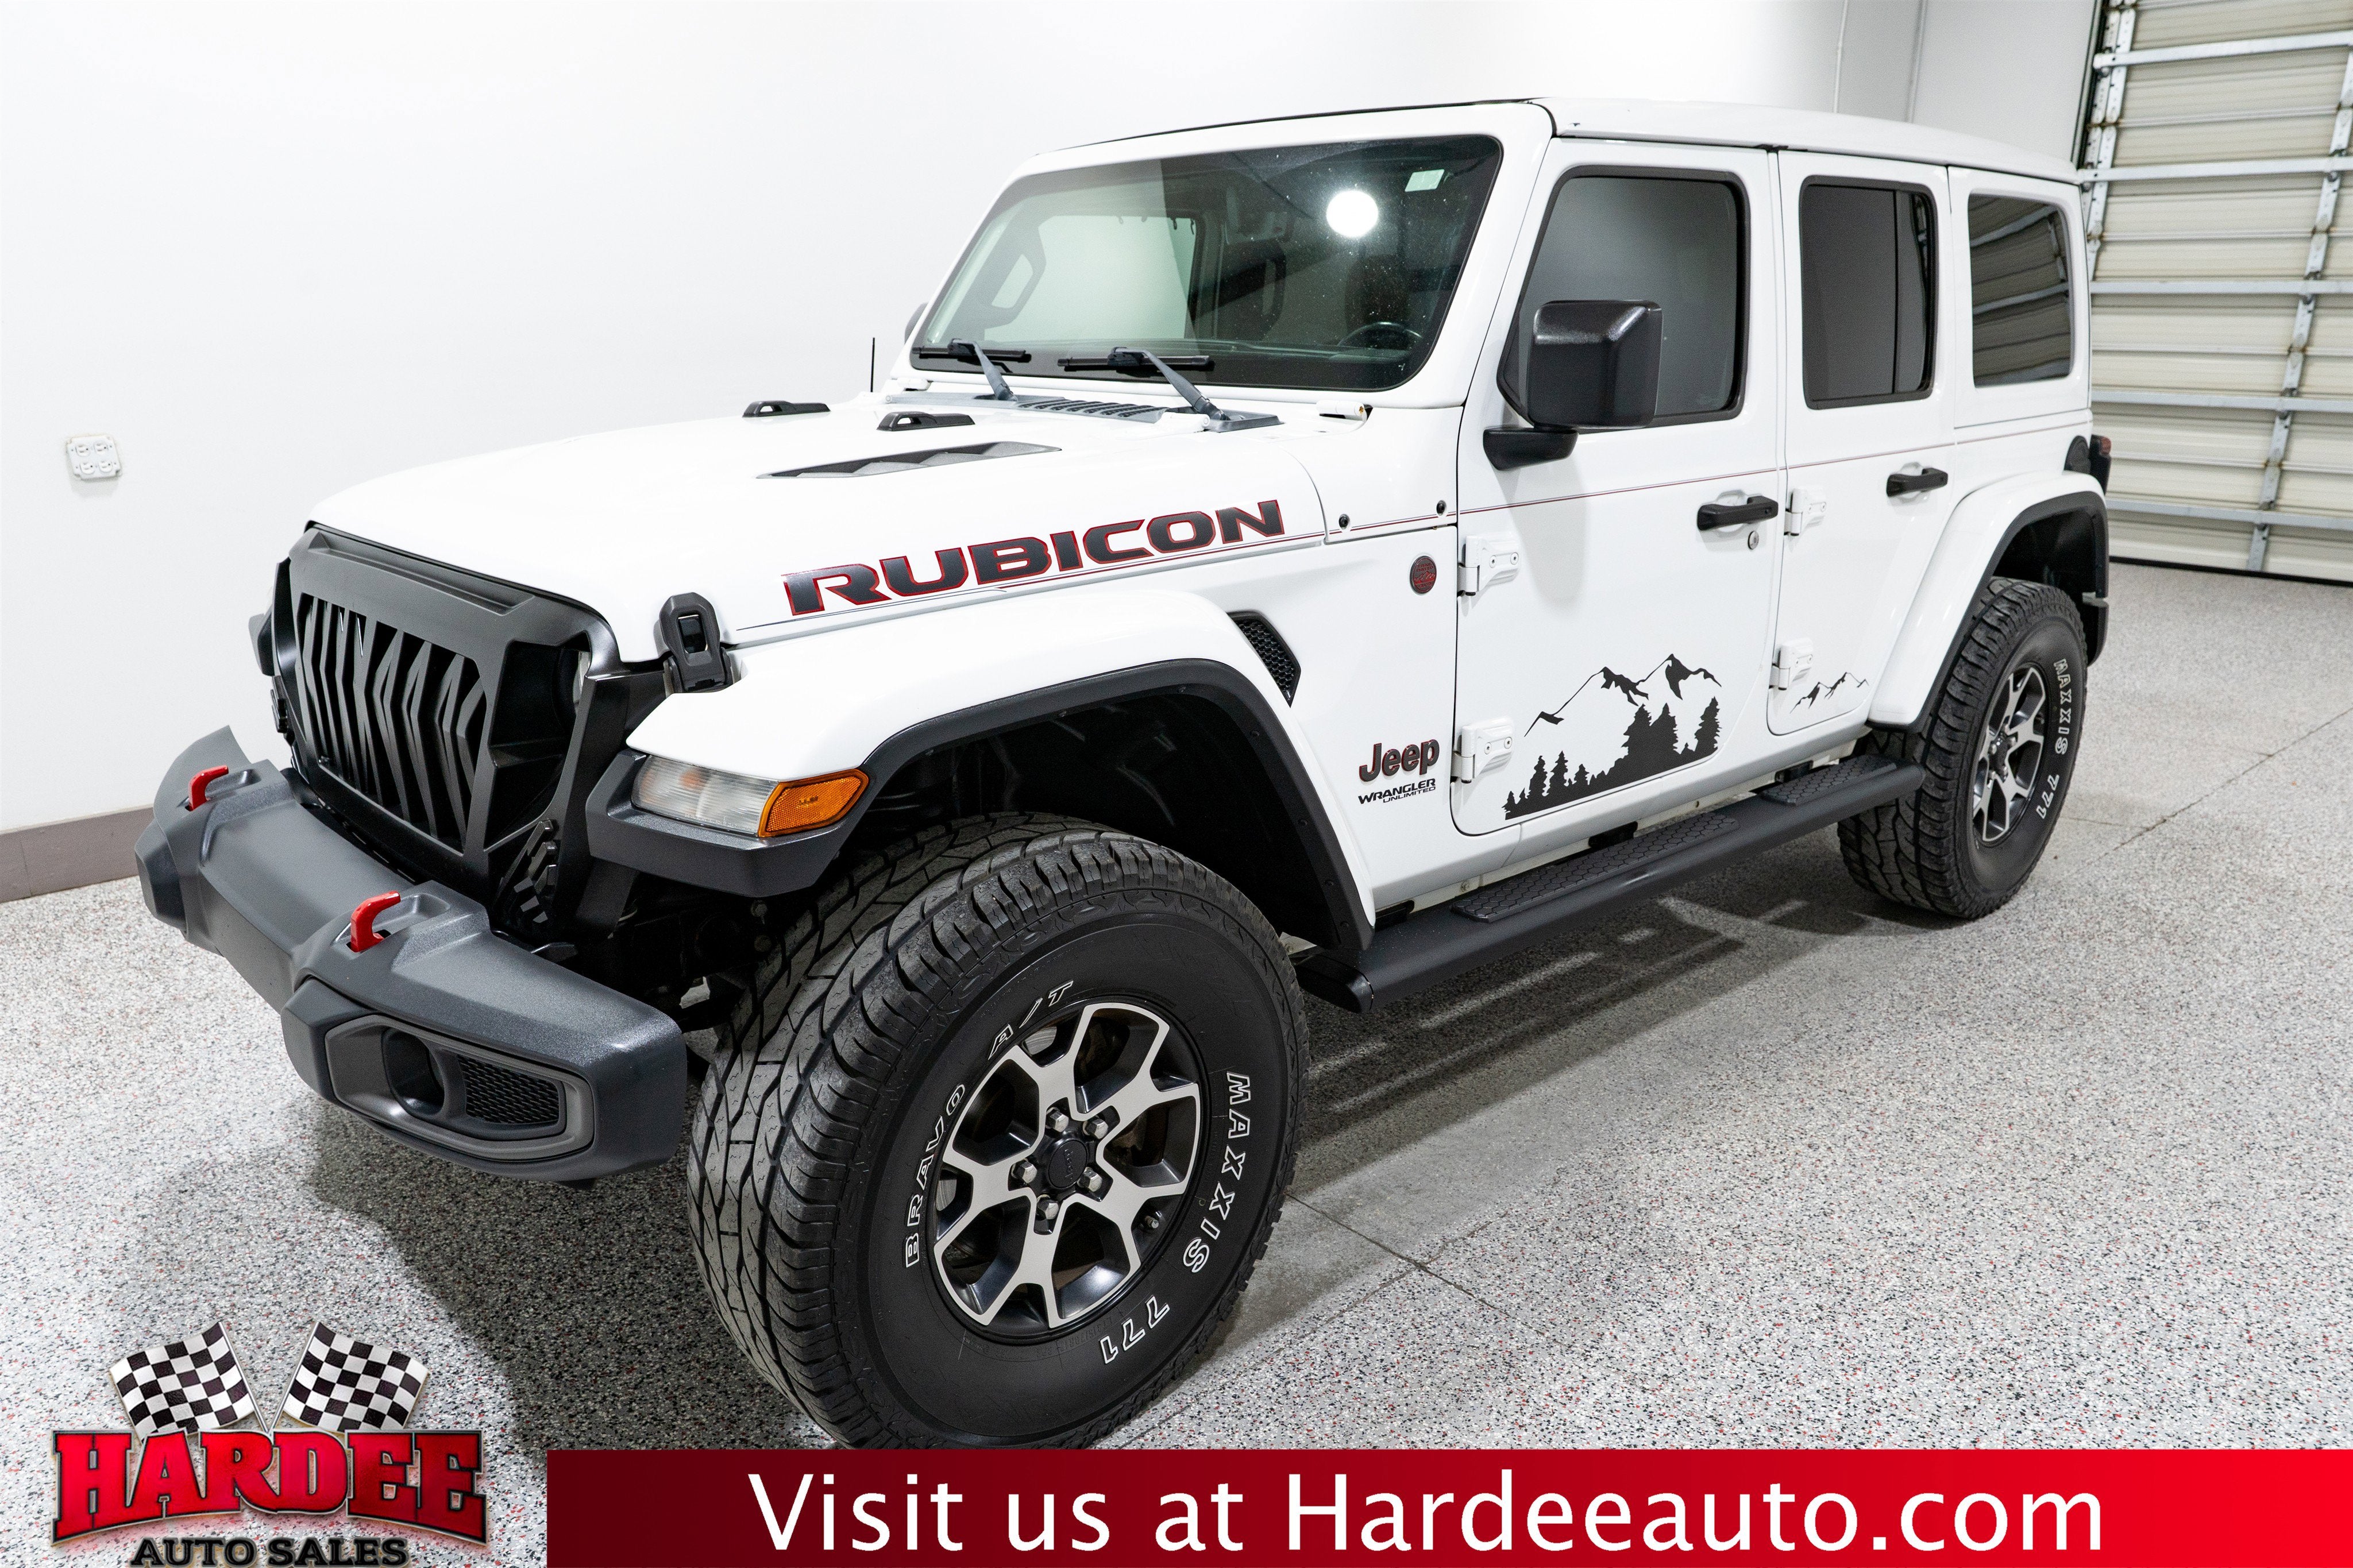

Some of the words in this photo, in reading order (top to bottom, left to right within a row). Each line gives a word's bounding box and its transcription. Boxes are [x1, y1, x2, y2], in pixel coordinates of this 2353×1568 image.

[781, 499, 1284, 616] RUBICON
[2054, 658, 2072, 755] MAXXIS
[1358, 778, 1436, 804] WRANGLER
[1359, 739, 1440, 782] Jeep
[1383, 786, 1436, 803] UNLIMITED
[2035, 773, 2059, 820] 771
[905, 1084, 966, 1268] BRAVO
[989, 980, 1074, 1060] A/T
[1183, 1072, 1251, 1273] MAXXIS
[1100, 1295, 1170, 1364] 771
